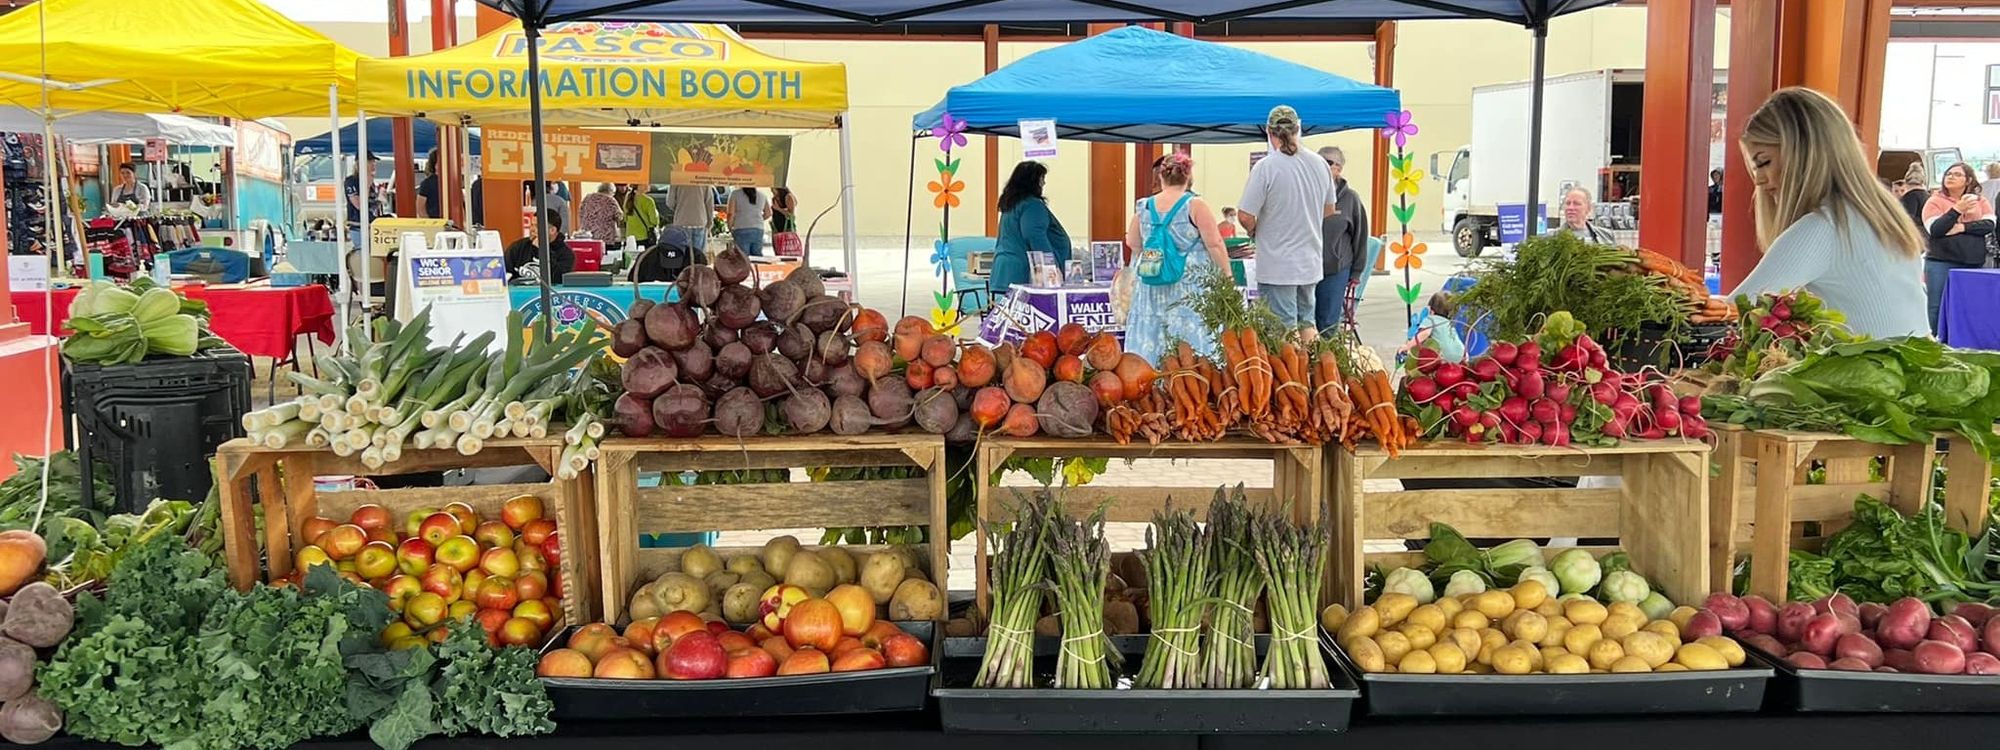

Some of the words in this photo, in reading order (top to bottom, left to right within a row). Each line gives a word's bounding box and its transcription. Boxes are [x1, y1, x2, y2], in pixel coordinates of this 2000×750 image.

[512, 36, 714, 57] PASCO
[406, 67, 665, 99] INFORMATION
[680, 69, 802, 99] BOOTH
[552, 133, 591, 145] HERE
[487, 140, 590, 175] EBT
[419, 258, 439, 268] WIC
[418, 266, 451, 277] SENIOR
[535, 294, 604, 311] FRMER'S
[1070, 302, 1104, 314] WALK
